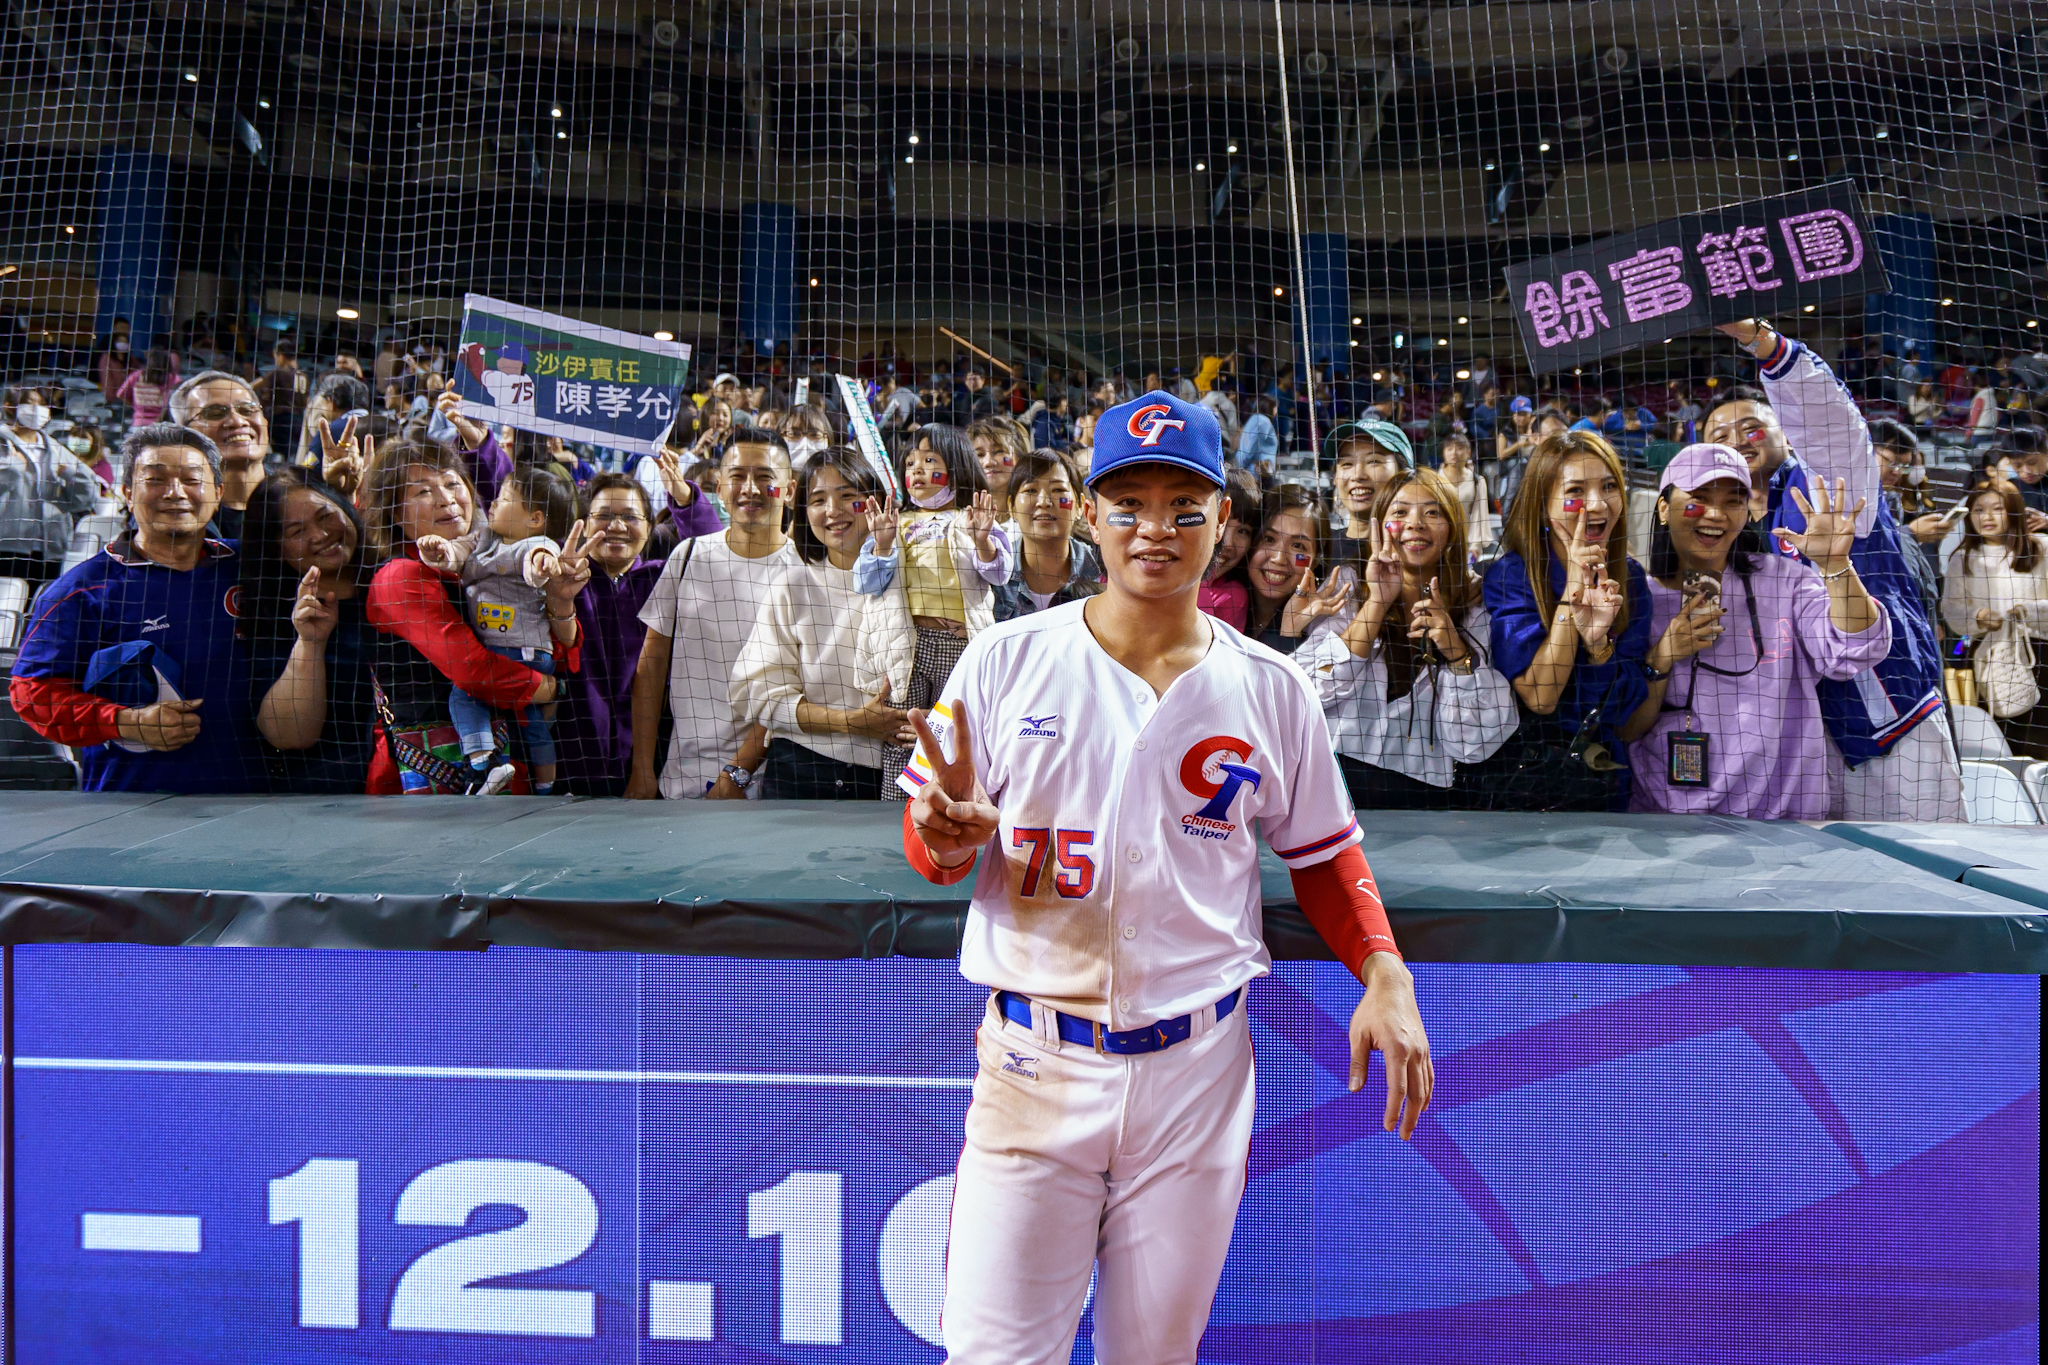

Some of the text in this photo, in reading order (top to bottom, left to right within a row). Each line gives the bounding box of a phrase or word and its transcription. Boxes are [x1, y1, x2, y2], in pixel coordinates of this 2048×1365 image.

[1524, 209, 1864, 348] 餘富範團
[534, 351, 640, 383] 沙伊責任
[511, 382, 533, 404] 75
[556, 381, 672, 420] 陳孝允
[1178, 516, 1203, 524] ACCUPRO
[1181, 815, 1236, 831] Chinese
[1182, 825, 1230, 840] Taipei
[1013, 827, 1095, 899] 75
